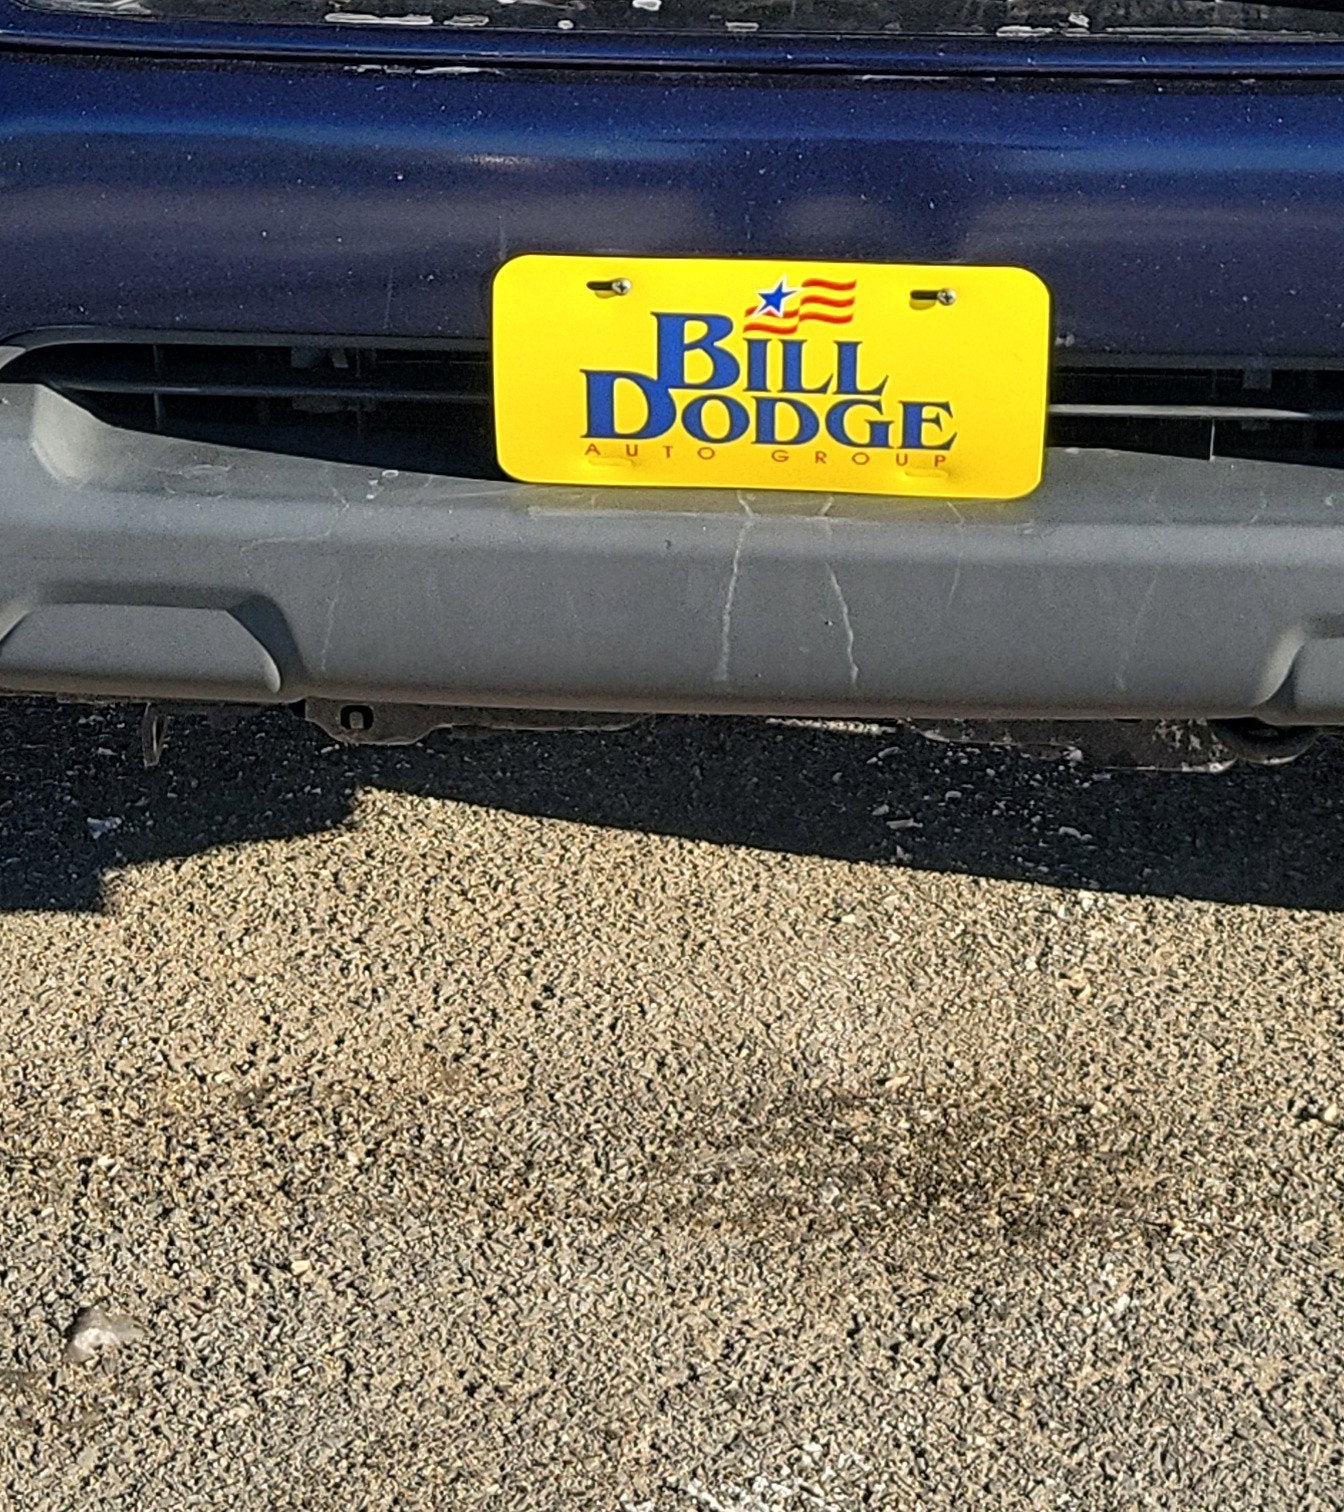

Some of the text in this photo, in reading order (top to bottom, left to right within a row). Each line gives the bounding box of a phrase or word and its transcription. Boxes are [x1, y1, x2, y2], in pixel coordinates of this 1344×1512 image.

[650, 311, 889, 395] BILL
[579, 369, 958, 451] DODGE
[584, 443, 946, 467] AUTO GROUP
